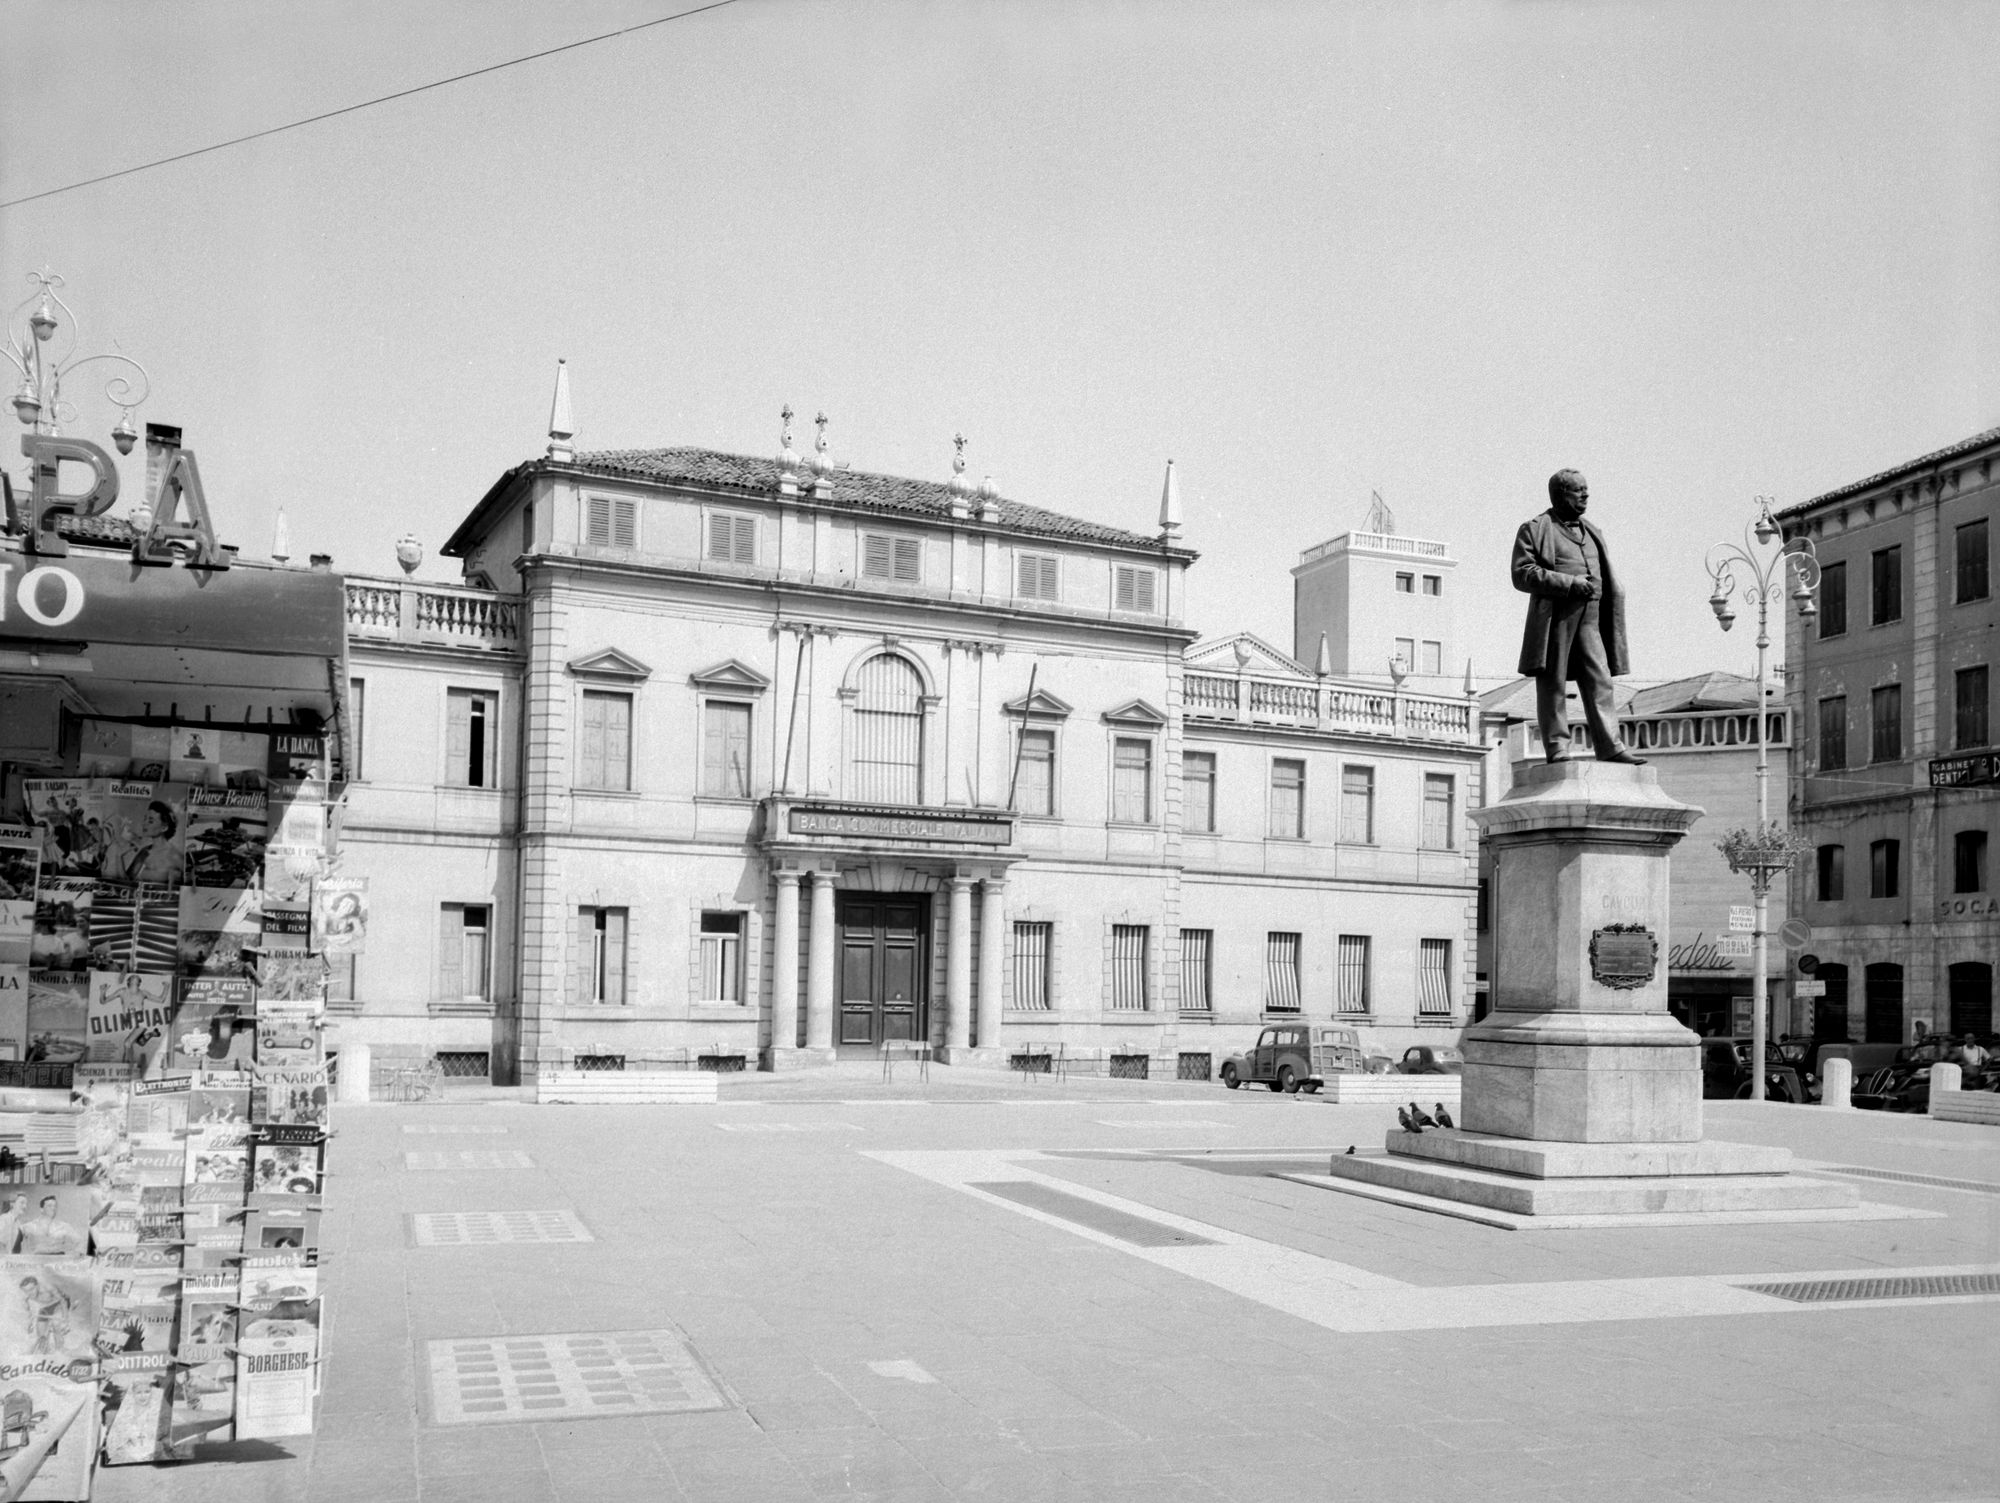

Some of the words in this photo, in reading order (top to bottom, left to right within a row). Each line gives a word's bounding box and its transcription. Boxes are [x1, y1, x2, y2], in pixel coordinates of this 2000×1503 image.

[276, 736, 287, 753] LA
[290, 737, 319, 755] DANZA
[191, 787, 223, 804] House
[0, 829, 32, 839] AVIA
[800, 815, 844, 831] BANCA
[850, 818, 943, 837] COMMERCIALE
[265, 923, 280, 932] DEL
[287, 924, 307, 932] FILM
[185, 982, 212, 991] INTER
[255, 1071, 325, 1087] SCENARIO
[0, 1359, 71, 1381] Candido
[247, 1352, 309, 1374] BORGHESE
